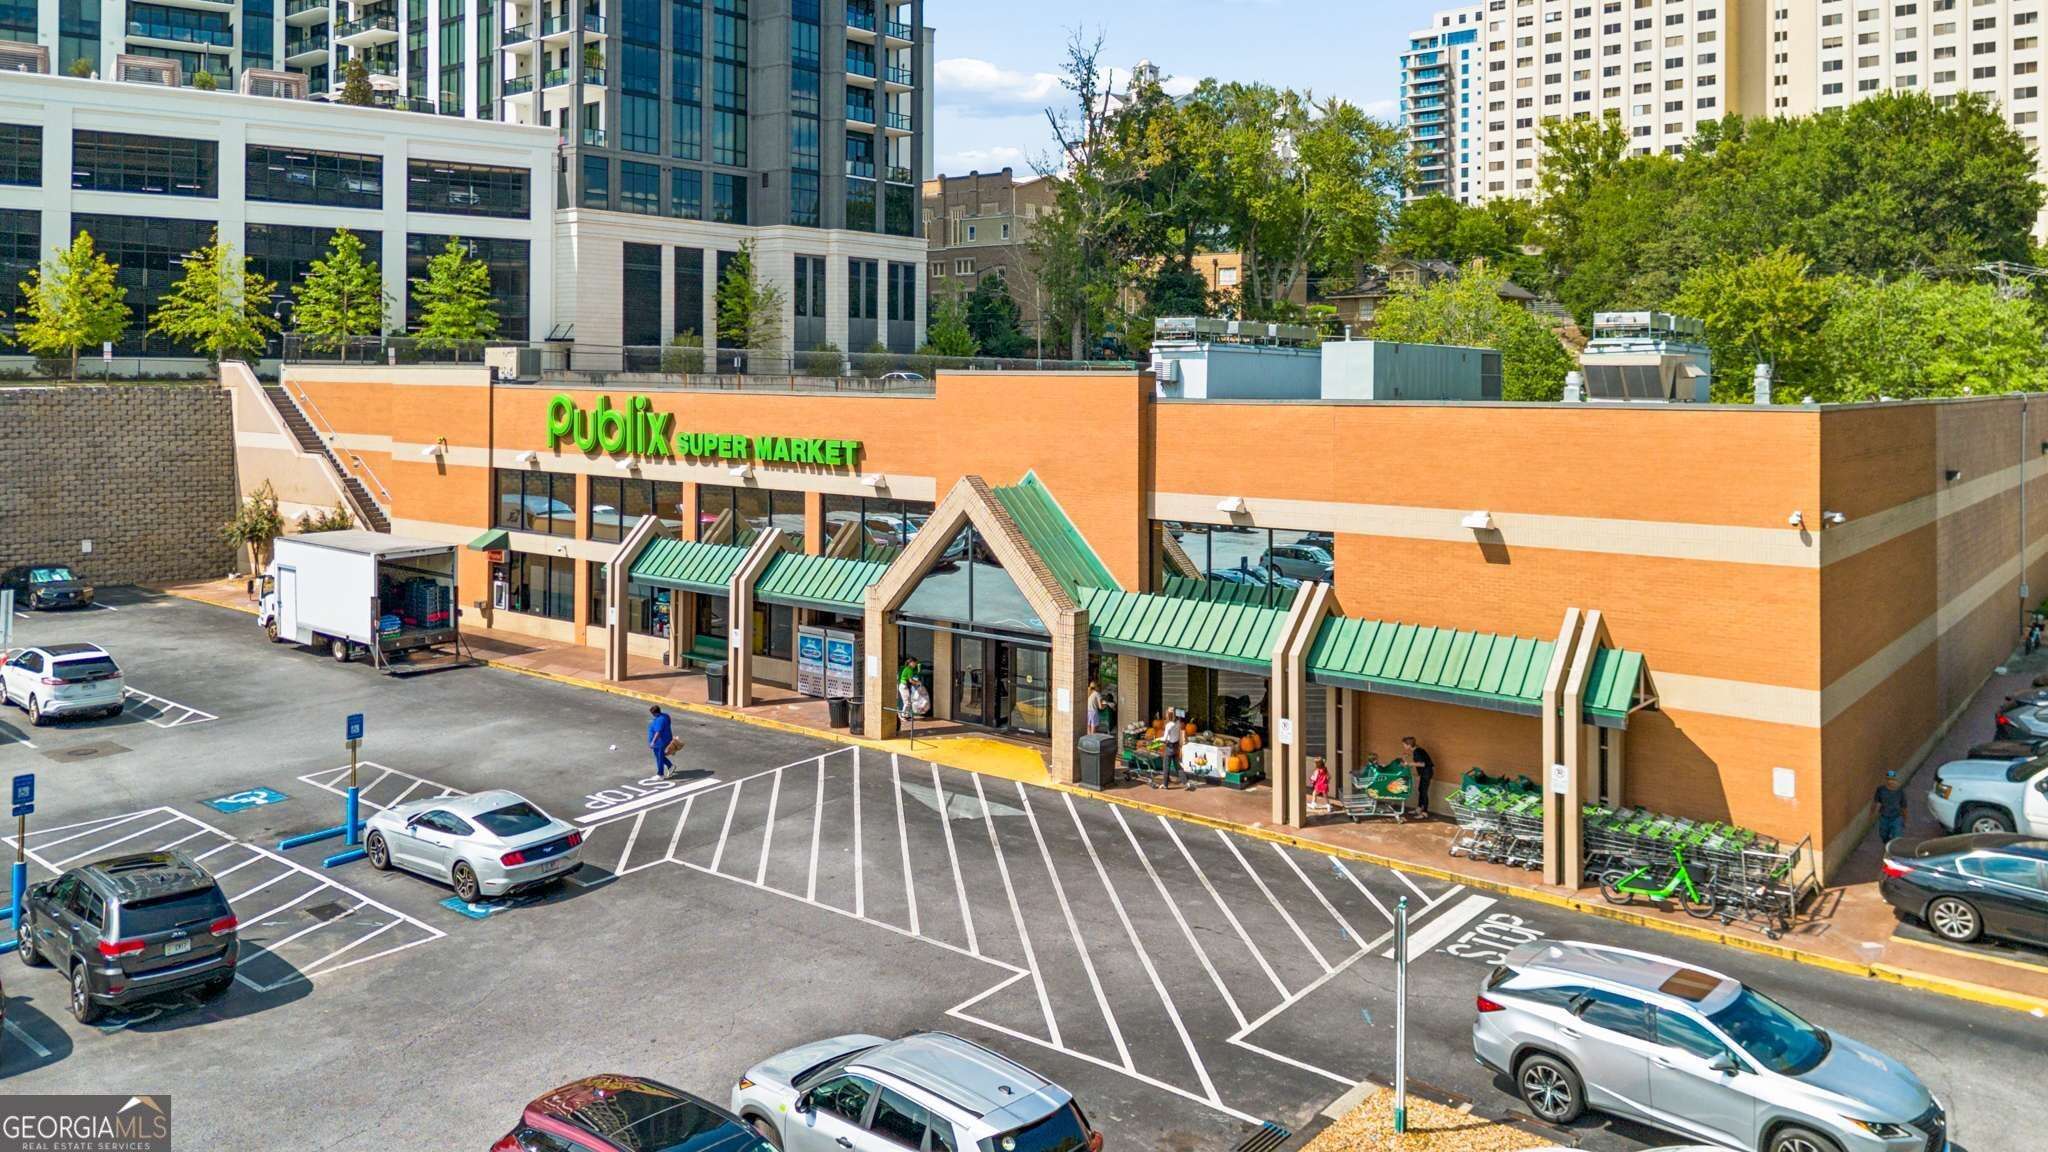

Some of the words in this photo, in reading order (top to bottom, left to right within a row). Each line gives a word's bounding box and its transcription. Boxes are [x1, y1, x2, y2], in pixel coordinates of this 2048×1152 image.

[546, 394, 670, 456] Publix
[676, 432, 748, 458] SUPER
[755, 437, 859, 465] MARKET
[584, 778, 676, 809] STOP
[1446, 913, 1545, 965] STOP
